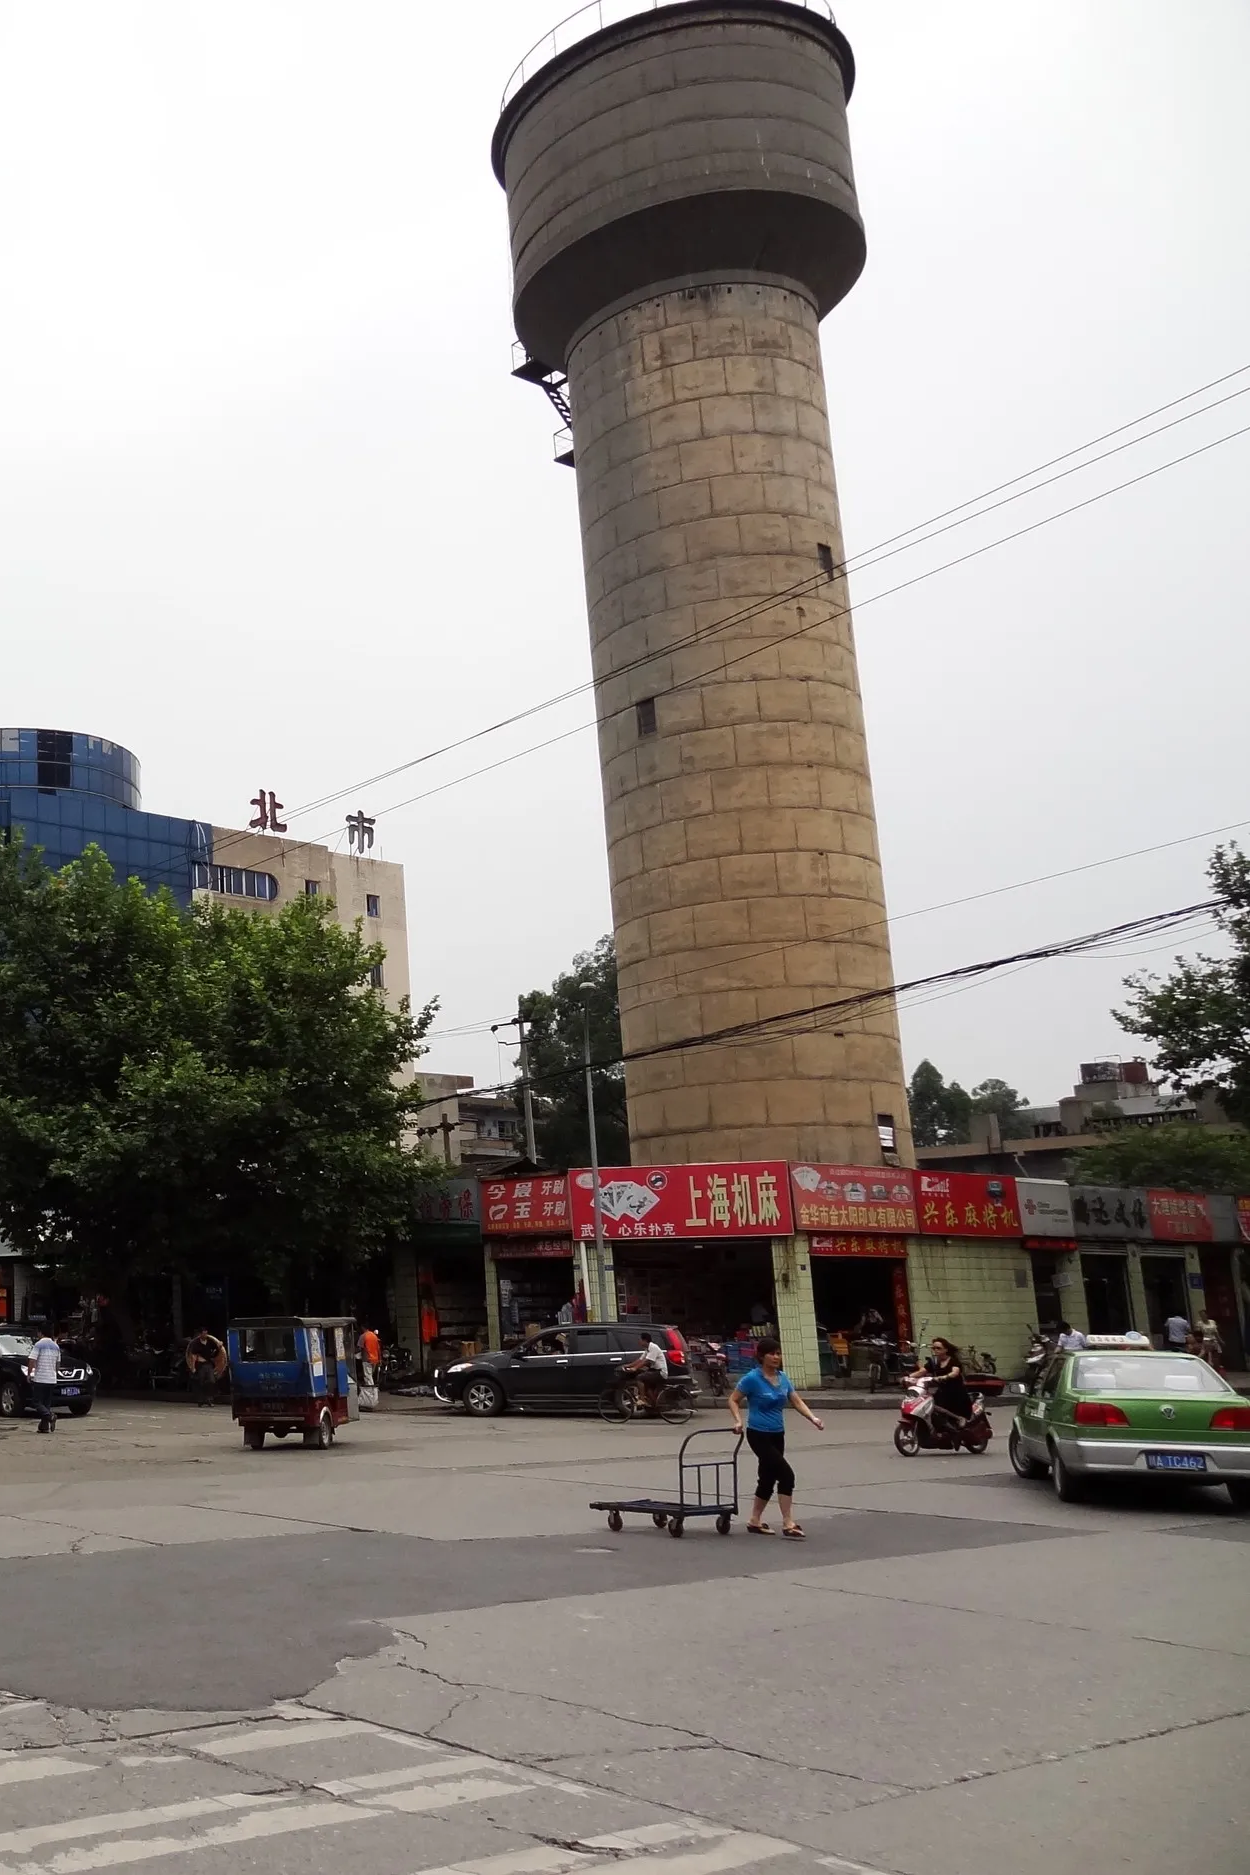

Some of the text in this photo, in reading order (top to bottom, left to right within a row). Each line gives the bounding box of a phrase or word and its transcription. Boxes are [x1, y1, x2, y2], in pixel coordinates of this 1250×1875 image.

[540, 1179, 565, 1196] 牙刷
[542, 1200, 567, 1217] 牙刷
[685, 1170, 780, 1229] 上海机麻
[799, 1202, 916, 1229] 金华市金太阳印业有限公司
[922, 1200, 1019, 1230] 兴乐麻将机
[618, 1222, 676, 1237] 心乐扑克
